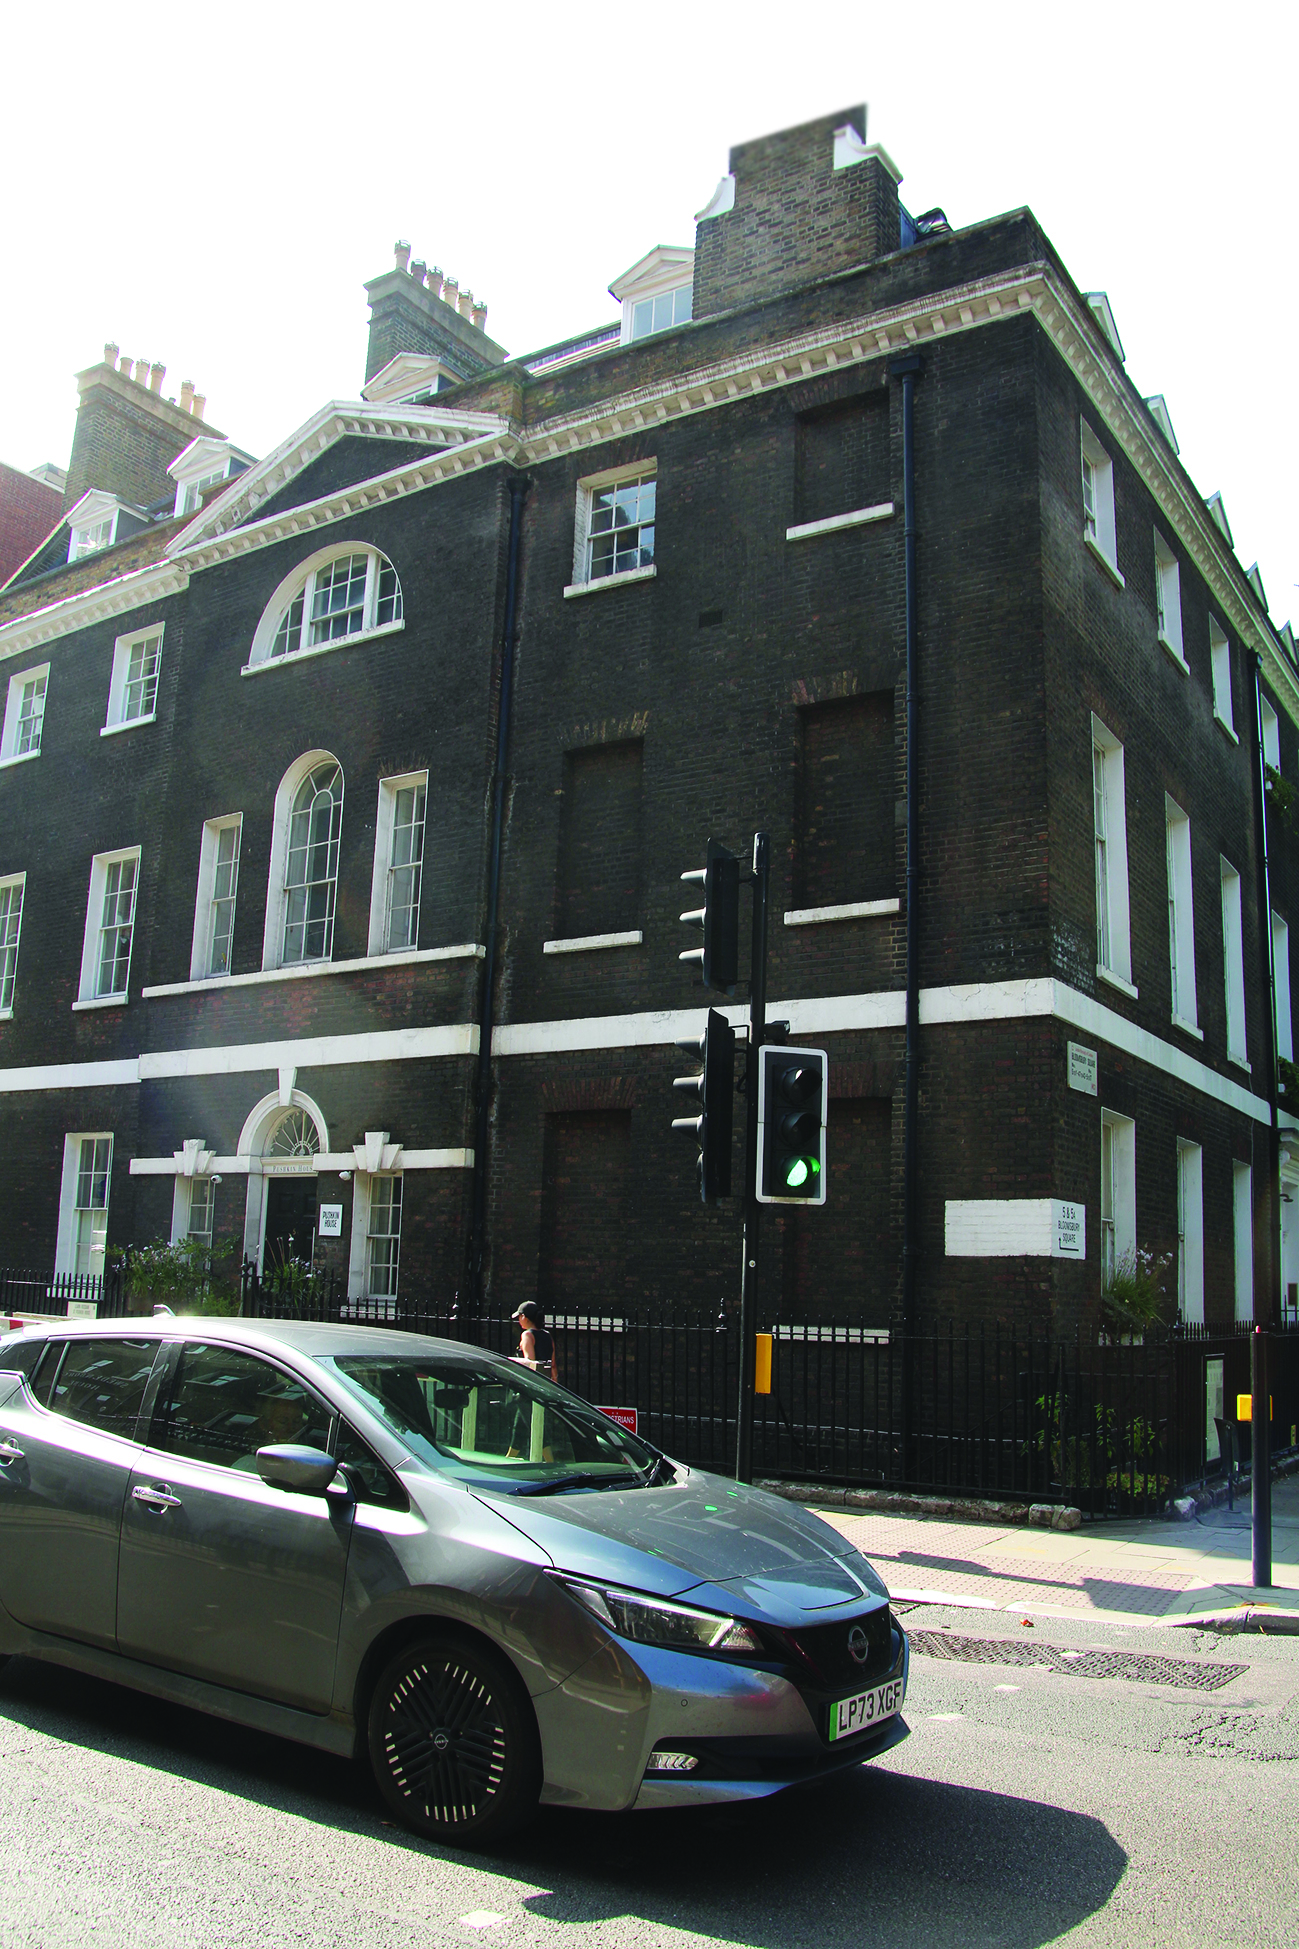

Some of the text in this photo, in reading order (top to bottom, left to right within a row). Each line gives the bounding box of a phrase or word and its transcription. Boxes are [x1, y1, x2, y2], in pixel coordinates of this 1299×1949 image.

[273, 1164, 313, 1173] PUSHKIN HOUS
[322, 1211, 340, 1220] PUSHKIN
[323, 1219, 338, 1228] HOUSE
[1058, 1220, 1080, 1232] BLOOMSBURY
[1062, 1232, 1076, 1244] SQUARE
[839, 1681, 902, 1733] LP73 XGF
